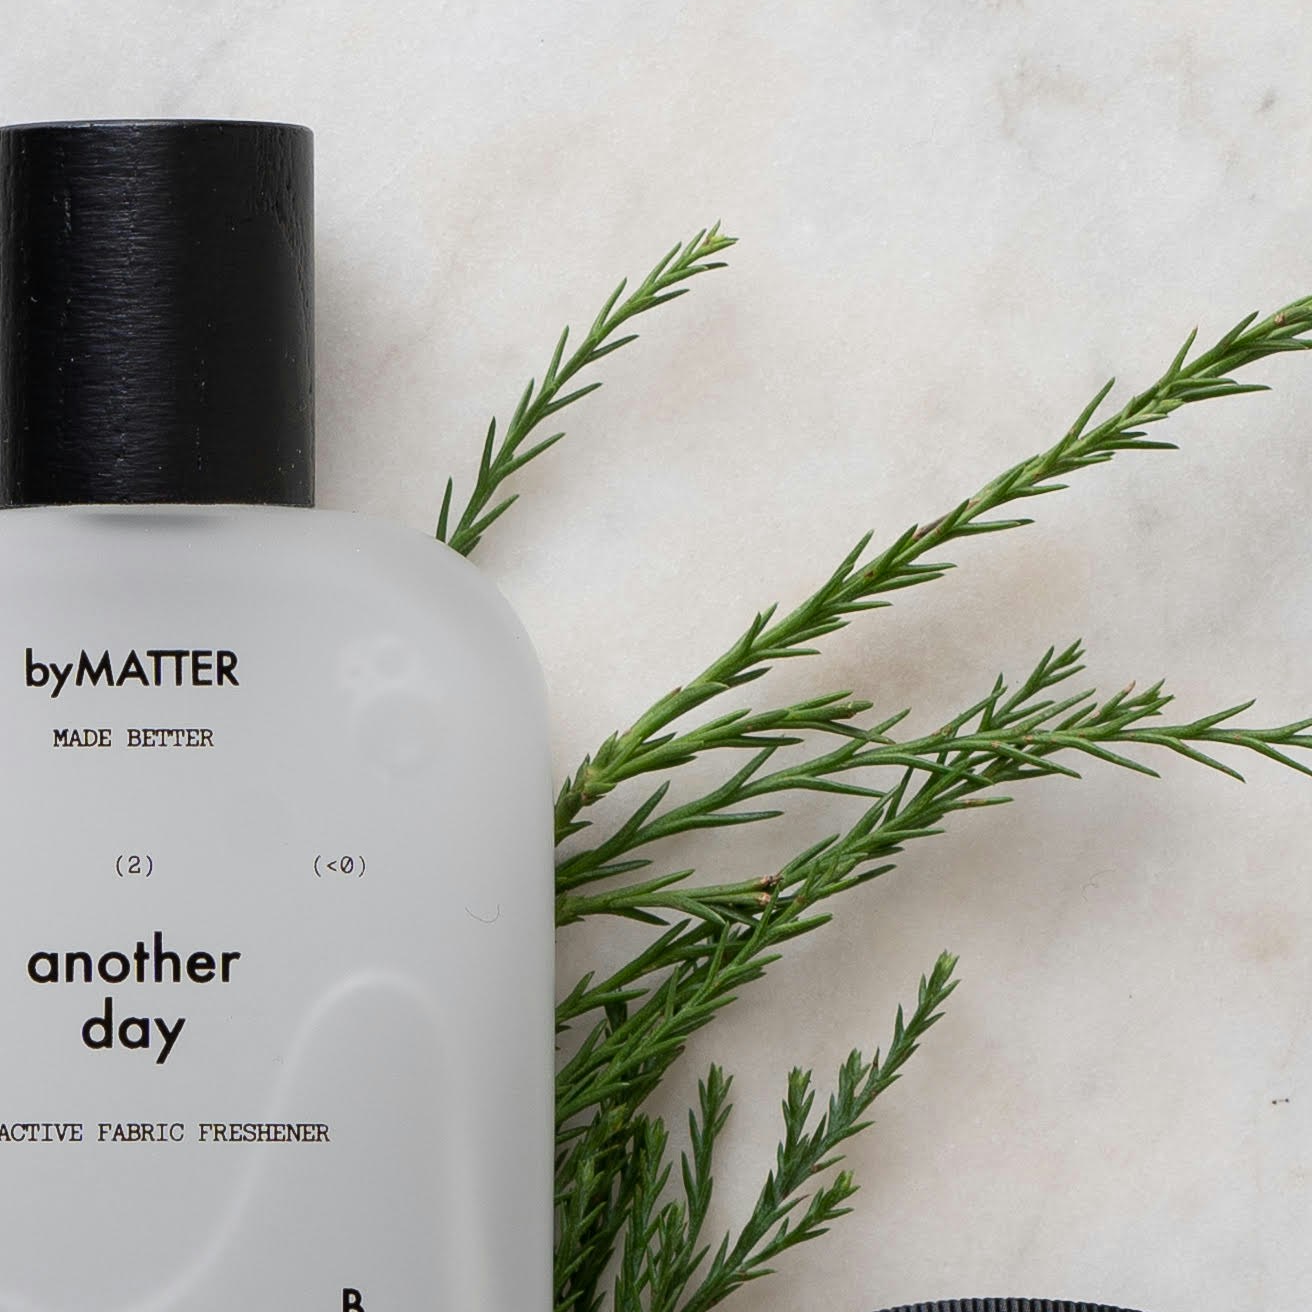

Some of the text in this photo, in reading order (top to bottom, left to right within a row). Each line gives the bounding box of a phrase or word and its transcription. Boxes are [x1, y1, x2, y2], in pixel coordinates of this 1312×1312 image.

[25, 648, 240, 698] byMATTER
[52, 728, 215, 748] MADE BETTER
[115, 855, 154, 878] (2)
[27, 931, 242, 984] another
[81, 997, 187, 1065] day
[97, 1122, 185, 1143] FABRIC
[198, 1122, 331, 1143] FRESHENER
